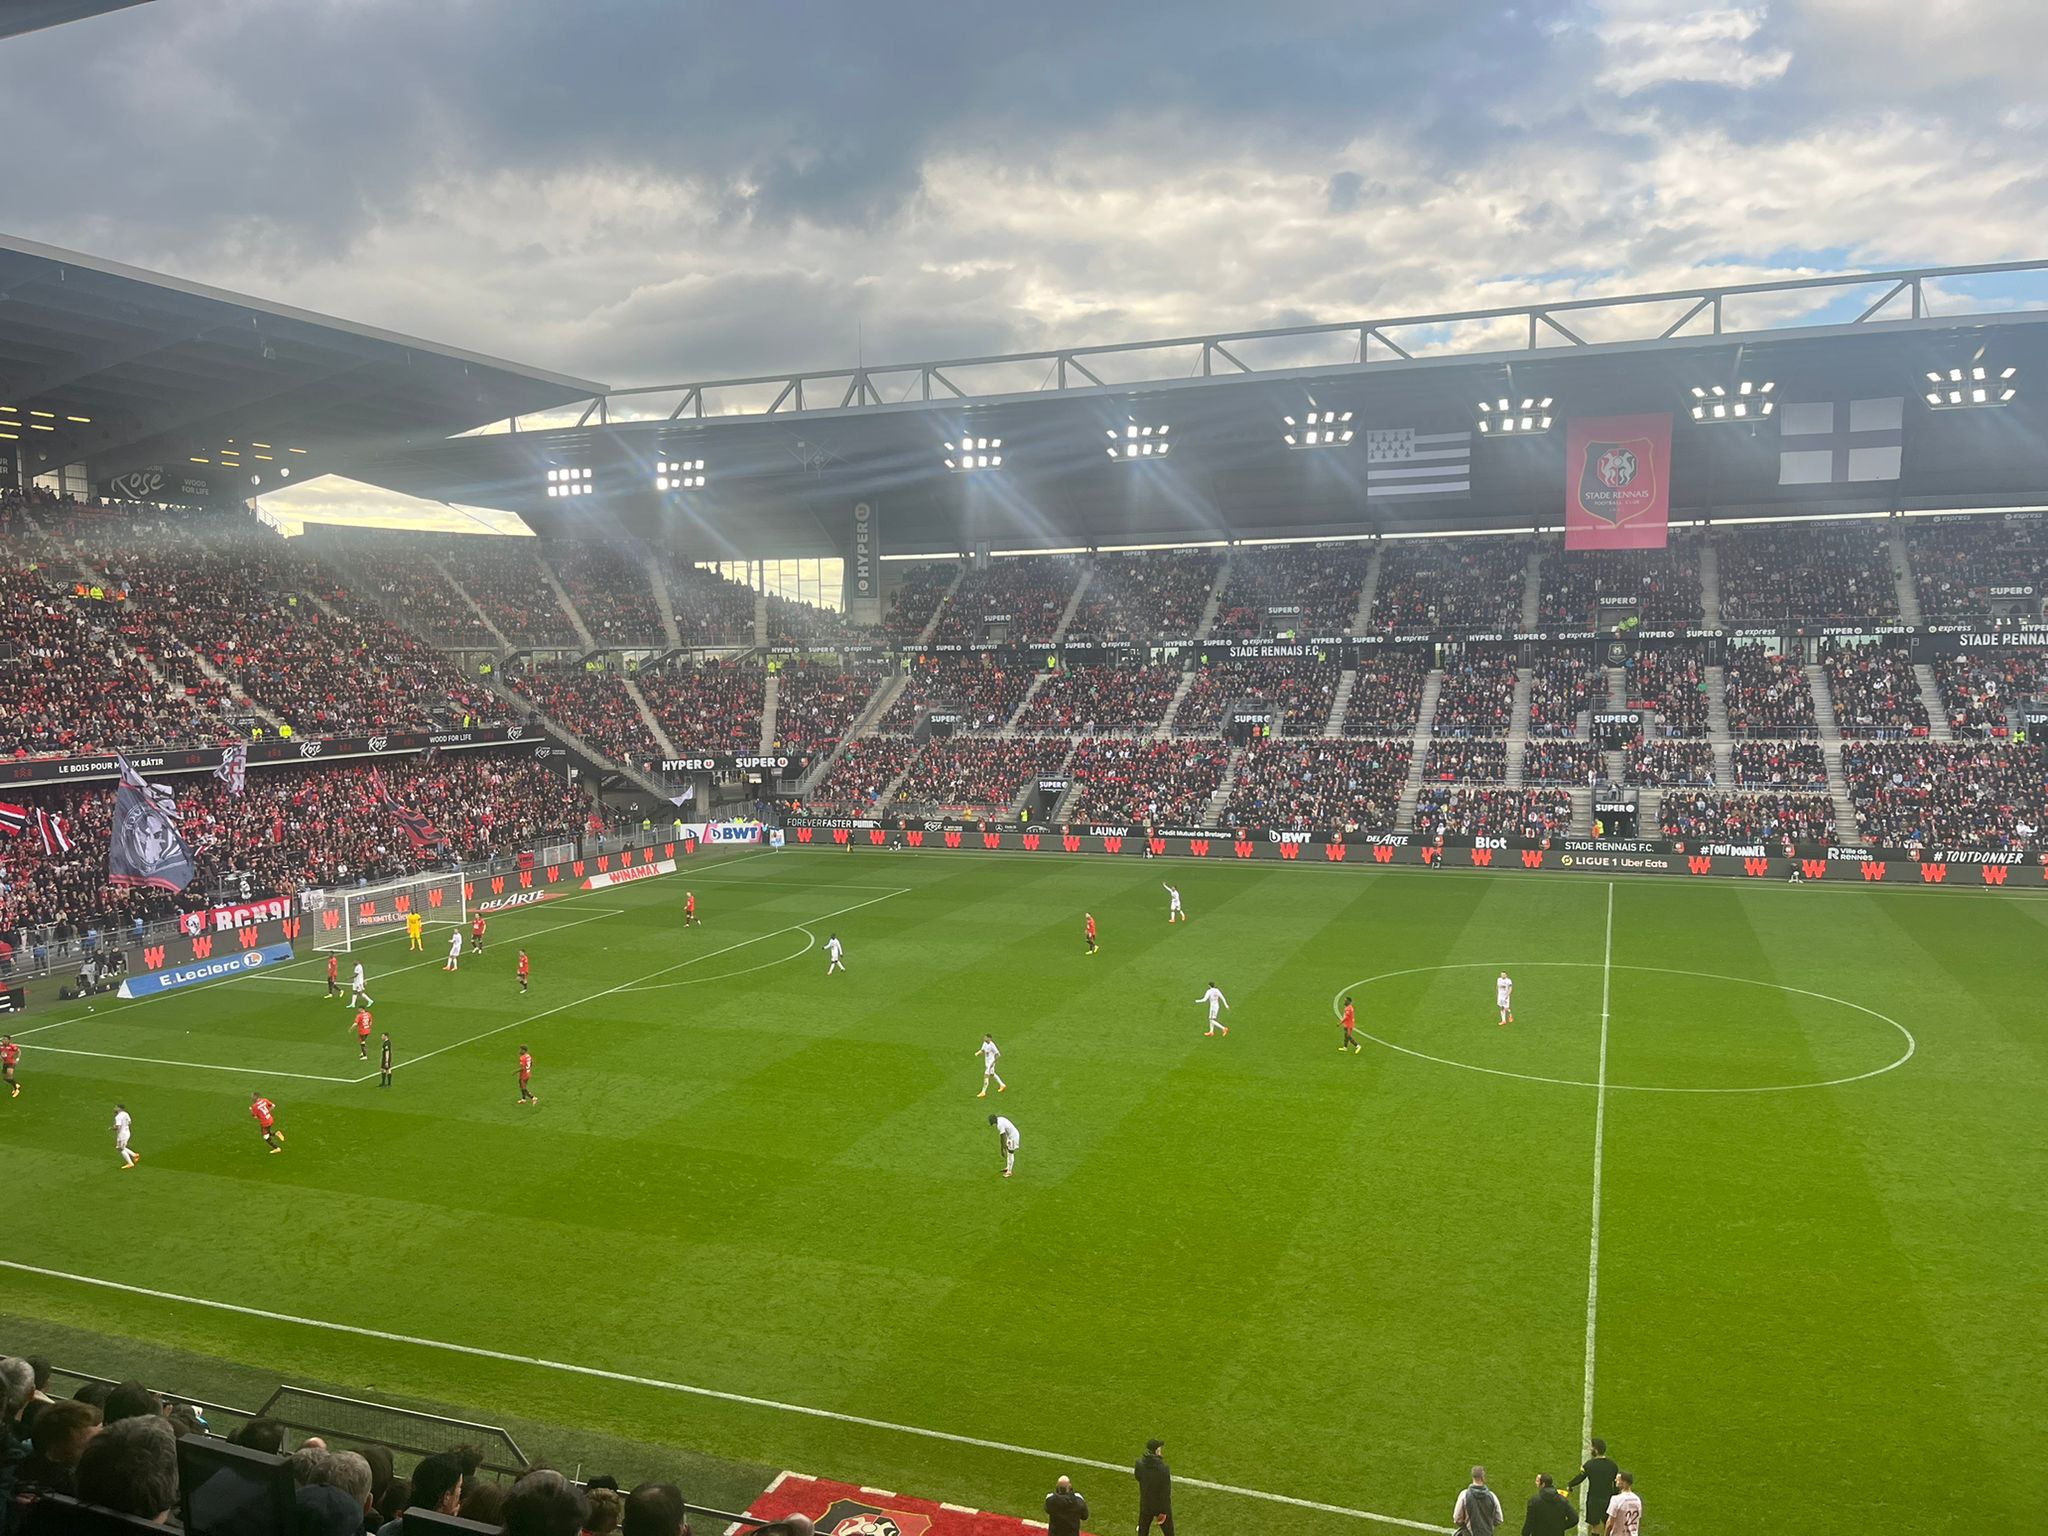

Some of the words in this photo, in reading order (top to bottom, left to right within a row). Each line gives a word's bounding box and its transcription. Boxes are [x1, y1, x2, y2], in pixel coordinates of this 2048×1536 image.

[184, 478, 207, 488] WOOD
[195, 487, 209, 496] LIFE
[1584, 491, 1611, 500] STADE
[1612, 489, 1650, 500] RENNAIS
[857, 521, 869, 577] HYPER
[1990, 586, 2022, 595] SUPER
[1268, 606, 1292, 614] SUPER
[1744, 628, 1776, 637] express
[1823, 627, 1853, 635] HYPER
[1874, 626, 1905, 634] SUPER
[1938, 624, 1972, 633] express
[2021, 624, 2048, 632] HYPE
[1402, 635, 1429, 643] express
[1566, 631, 1595, 640] express
[1686, 630, 1714, 638] SUPER
[1959, 633, 1999, 646] STADE
[1230, 646, 1259, 657] STADE
[1261, 645, 1304, 657] RENNAIS
[931, 715, 956, 723] SUPER
[1234, 714, 1264, 723] SUPER
[1594, 714, 1628, 723] SUPER
[429, 735, 447, 744] WOOD
[448, 734, 459, 743] FOR
[460, 733, 472, 741] LIFE
[299, 741, 323, 759] Rose
[368, 736, 388, 753] Rose
[59, 765, 69, 774] LE
[70, 763, 90, 773] BOIS
[91, 762, 113, 772] POUR
[141, 758, 164, 767] BÂTIR
[662, 759, 703, 773] HYPER
[735, 758, 776, 769] SUPER
[1039, 781, 1062, 789] SUPER
[1595, 804, 1626, 812] SUPER
[722, 827, 759, 840] BWT
[1090, 826, 1129, 837] LAUNAY
[1158, 828, 1176, 837] Crédit
[1176, 829, 1196, 837] Mutuel
[1196, 830, 1204, 838] de
[1204, 830, 1232, 839] Bretagne
[1281, 833, 1312, 844] BWT
[1475, 836, 1508, 850] Blot
[1564, 841, 1594, 851] STADE
[1595, 842, 1637, 853] RENNAIS
[1638, 843, 1655, 853] F.C.
[1575, 856, 1610, 866] LIGUE
[1611, 857, 1618, 867] 1
[1620, 858, 1644, 868] Uber
[1644, 859, 1669, 869] Eats
[609, 863, 660, 885] WINAMAX
[159, 959, 241, 987] E.Leclerc
[1624, 1510, 1639, 1527] 22
